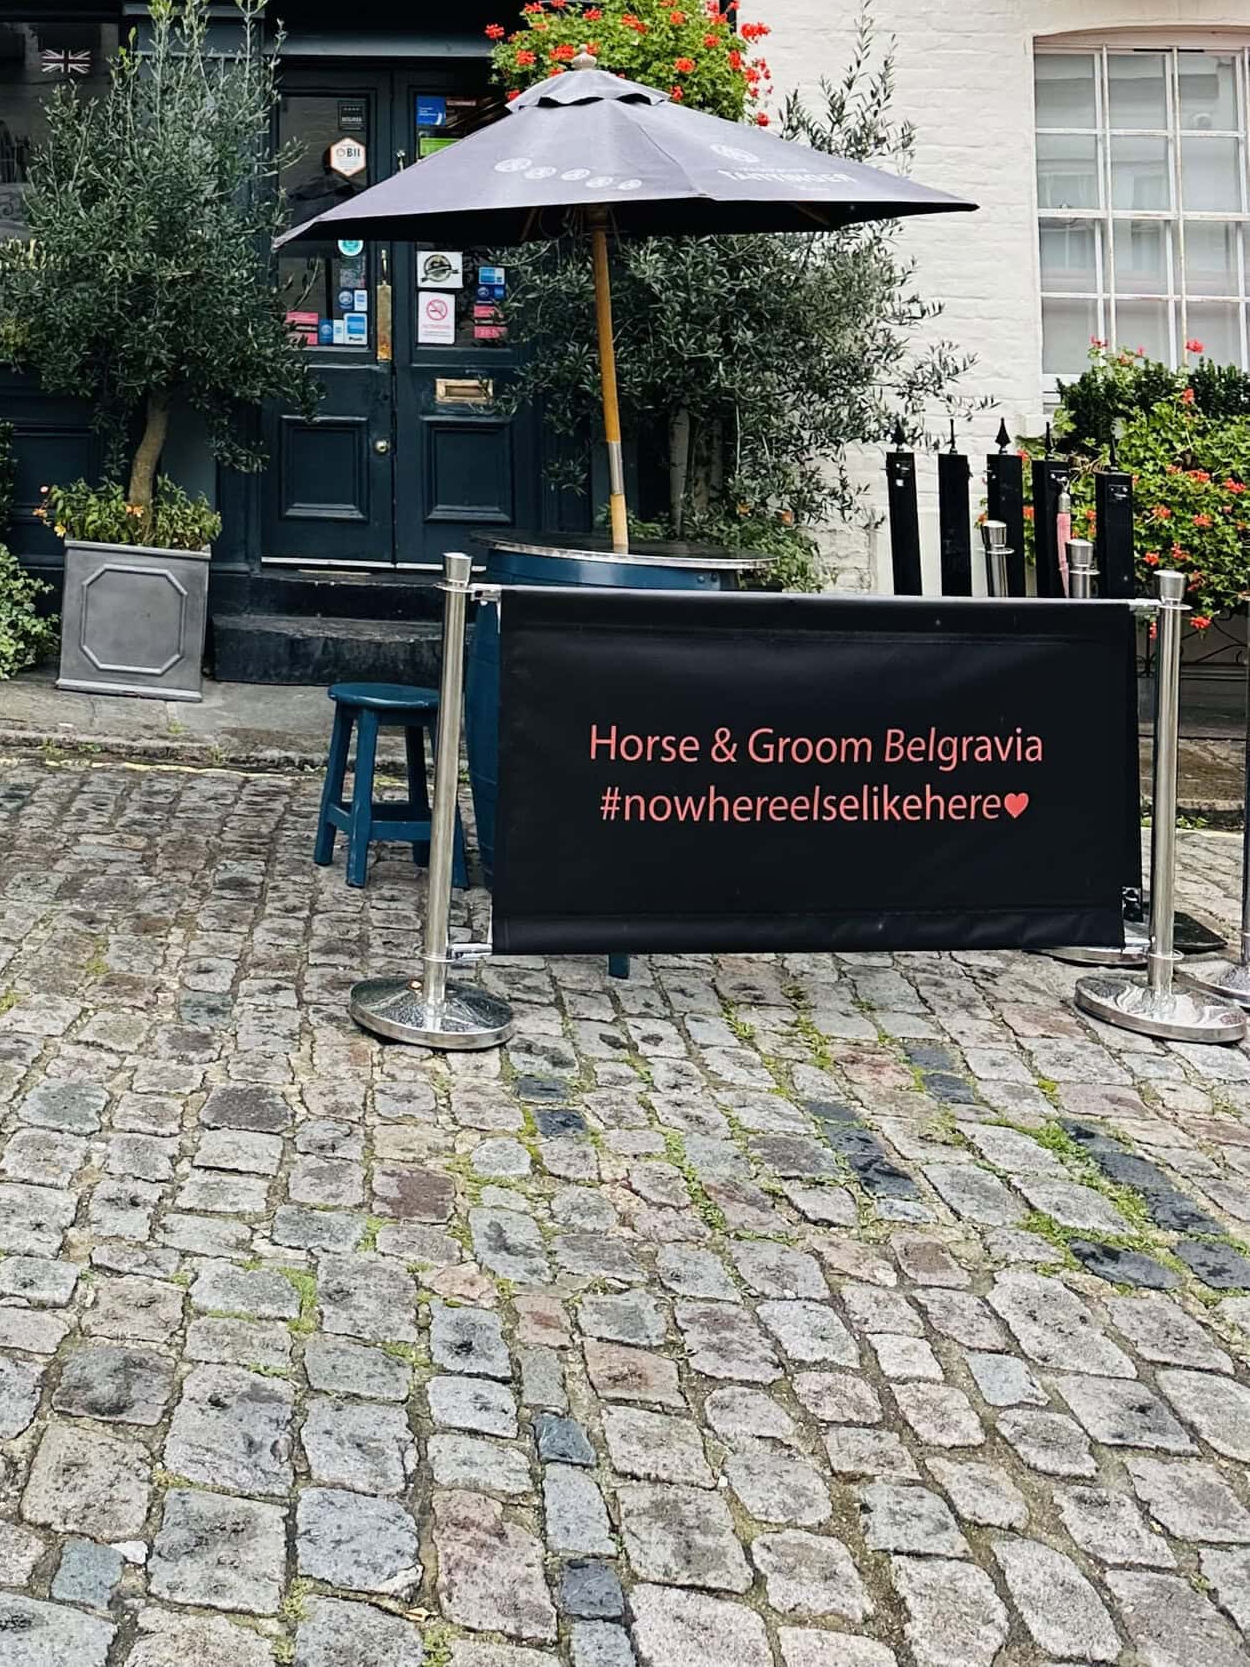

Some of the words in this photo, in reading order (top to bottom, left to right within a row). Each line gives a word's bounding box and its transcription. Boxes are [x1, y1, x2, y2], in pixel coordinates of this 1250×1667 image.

[589, 723, 701, 763] Horse
[710, 726, 738, 764] &
[748, 727, 873, 764] Groom
[884, 725, 1045, 772] Belgravia
[599, 784, 1003, 823] #nowhereelselikehere
